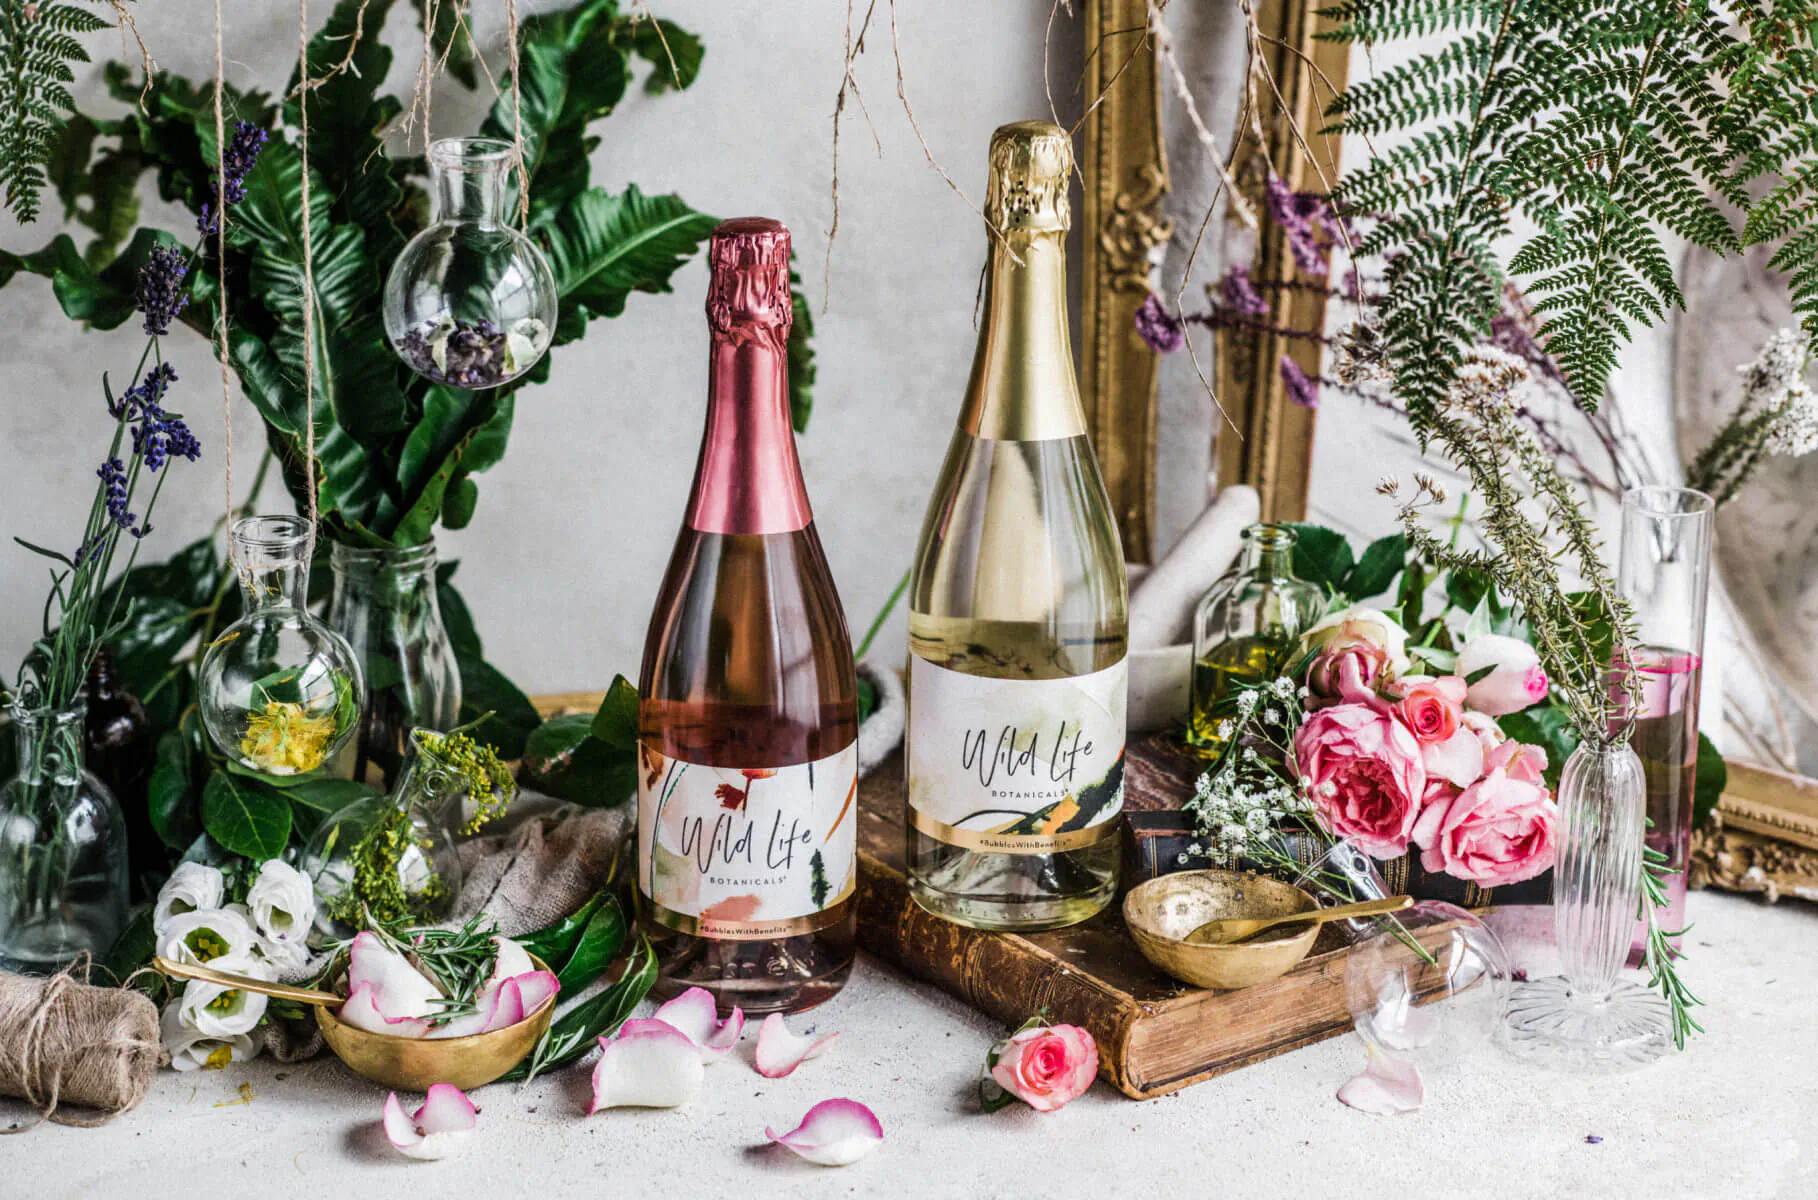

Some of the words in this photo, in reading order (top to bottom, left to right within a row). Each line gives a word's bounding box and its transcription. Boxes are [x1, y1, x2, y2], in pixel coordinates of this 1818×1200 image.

[962, 725, 1038, 787] Wild
[1050, 720, 1093, 782] Life
[682, 813, 753, 875] Wild
[766, 809, 812, 870] Life
